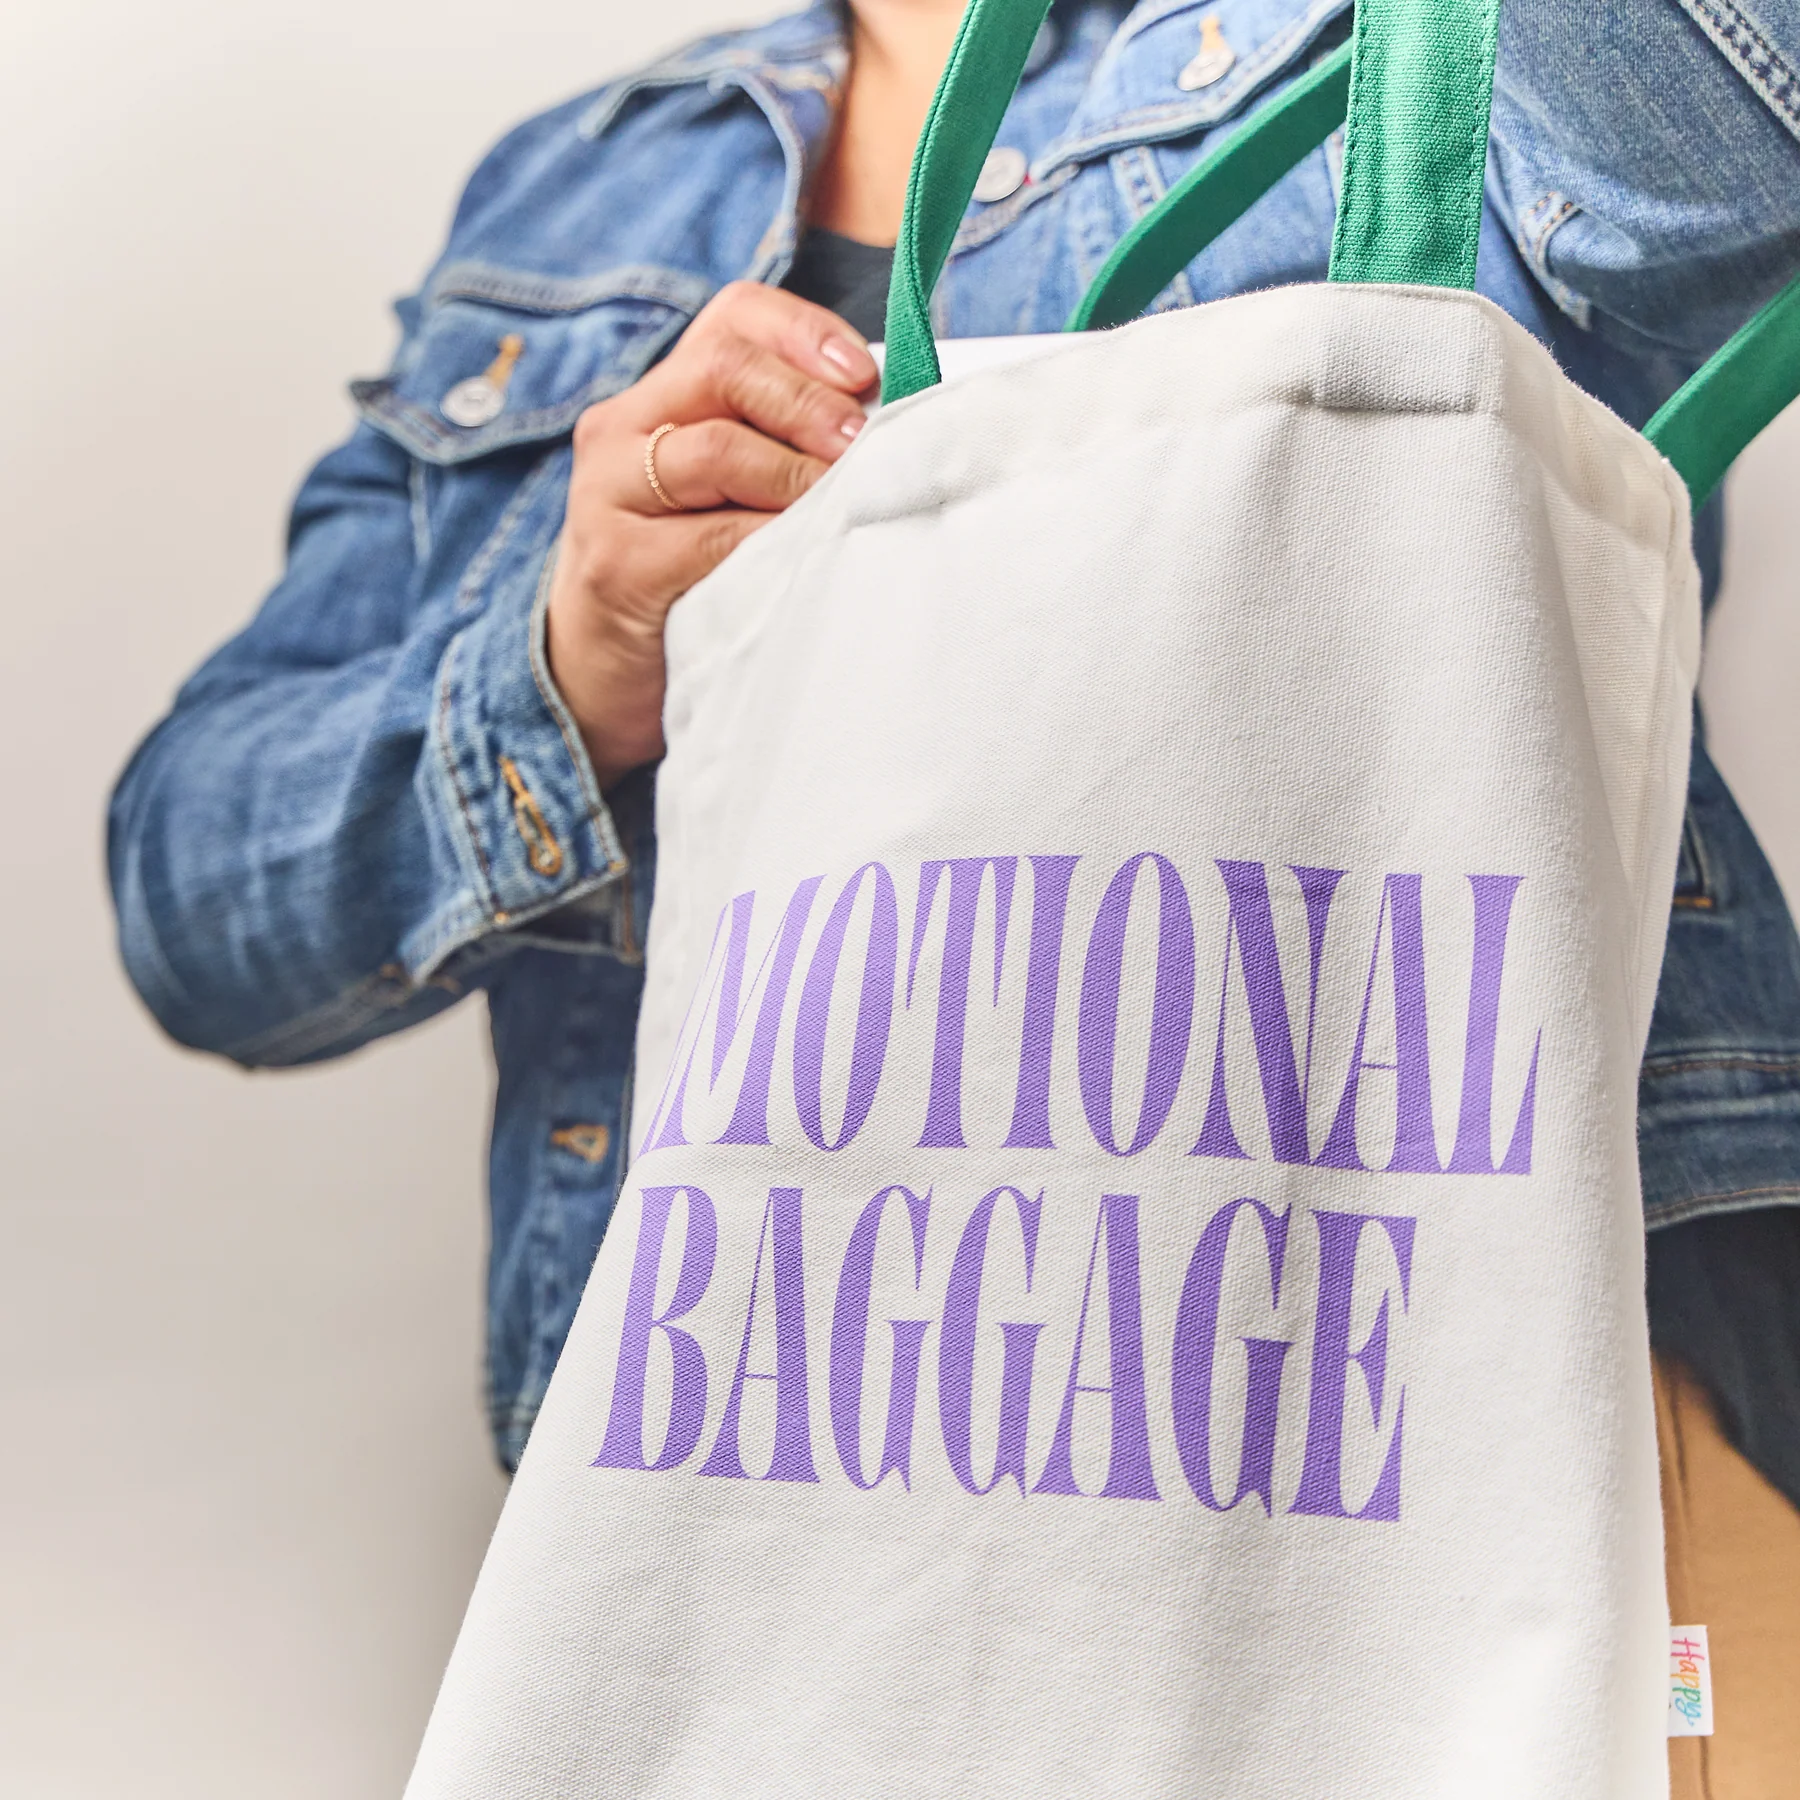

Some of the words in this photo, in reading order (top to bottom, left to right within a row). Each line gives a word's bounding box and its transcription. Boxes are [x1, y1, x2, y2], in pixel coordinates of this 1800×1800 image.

[634, 851, 1541, 1175] MOTIONAL
[590, 1184, 1417, 1523] BAGGAGE
[1670, 1637, 1705, 1727] Happy
